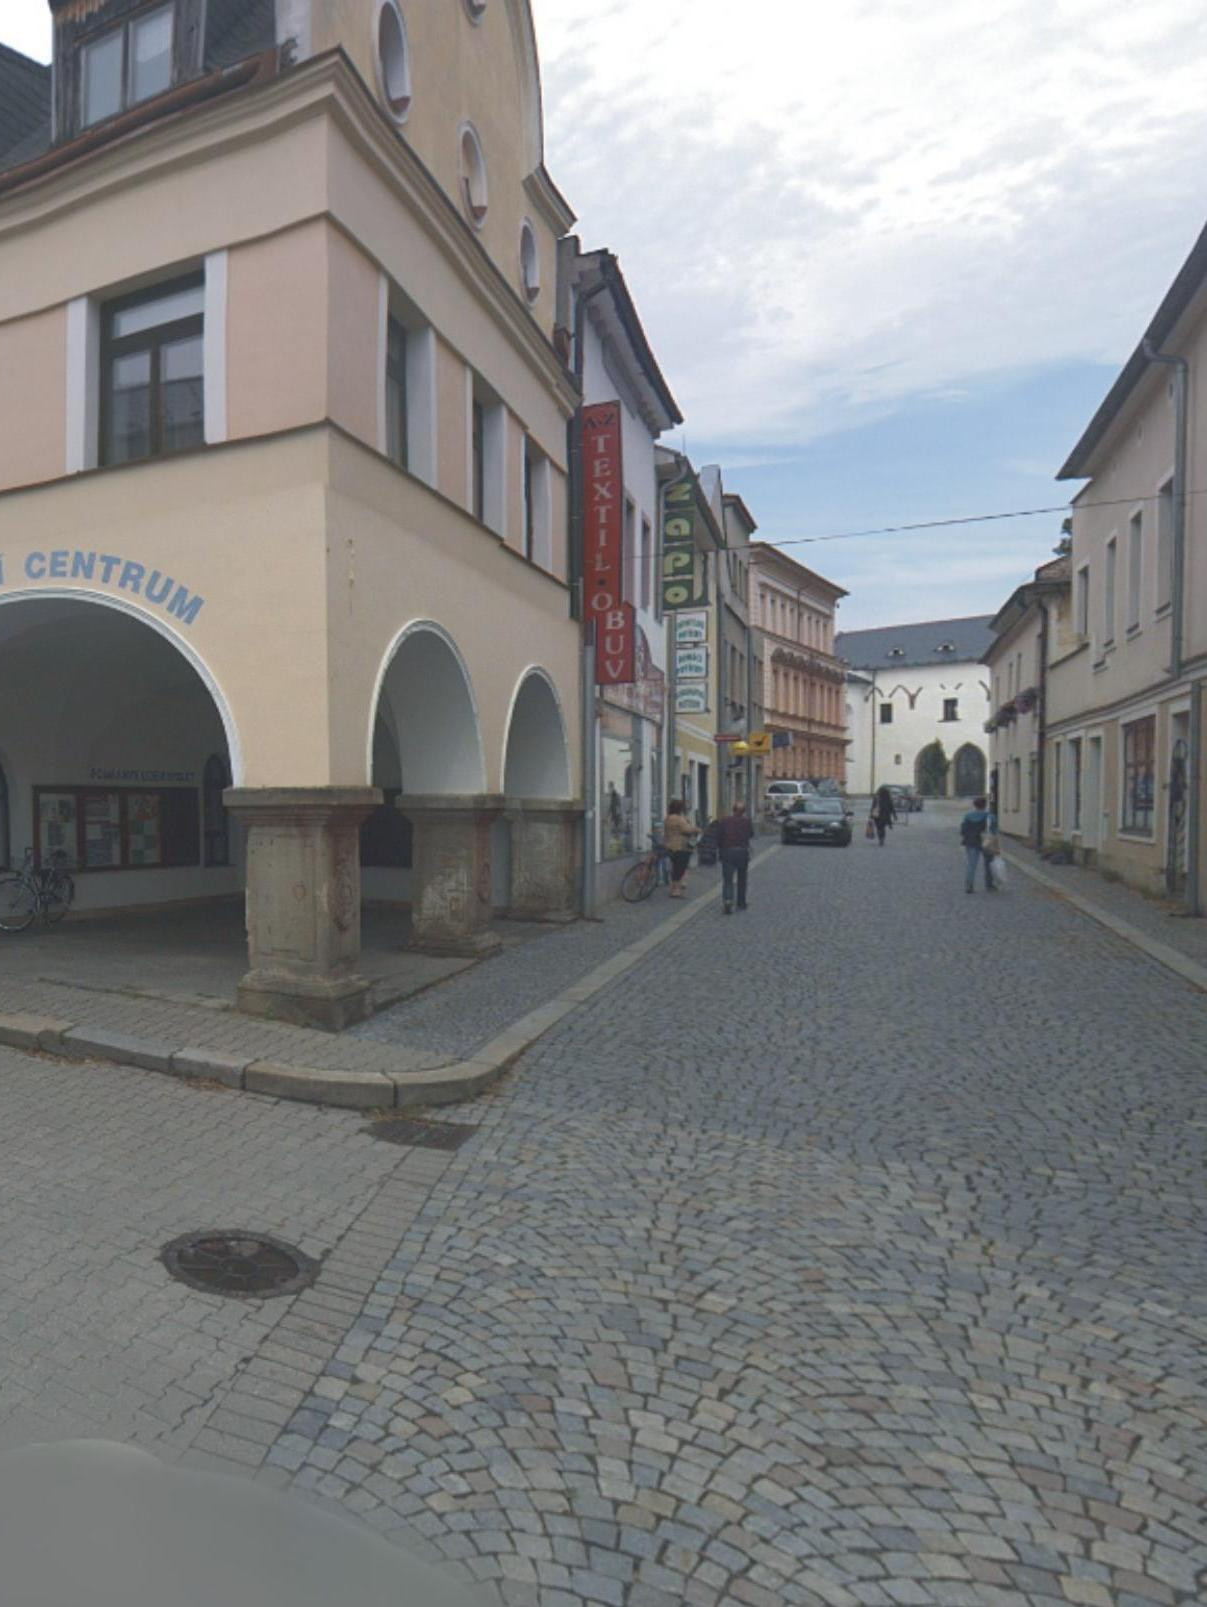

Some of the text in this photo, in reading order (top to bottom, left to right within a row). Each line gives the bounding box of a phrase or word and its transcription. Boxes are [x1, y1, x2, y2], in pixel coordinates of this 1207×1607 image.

[24, 549, 205, 625] CENTRUM
[592, 434, 625, 679] TEXTIL OBUV
